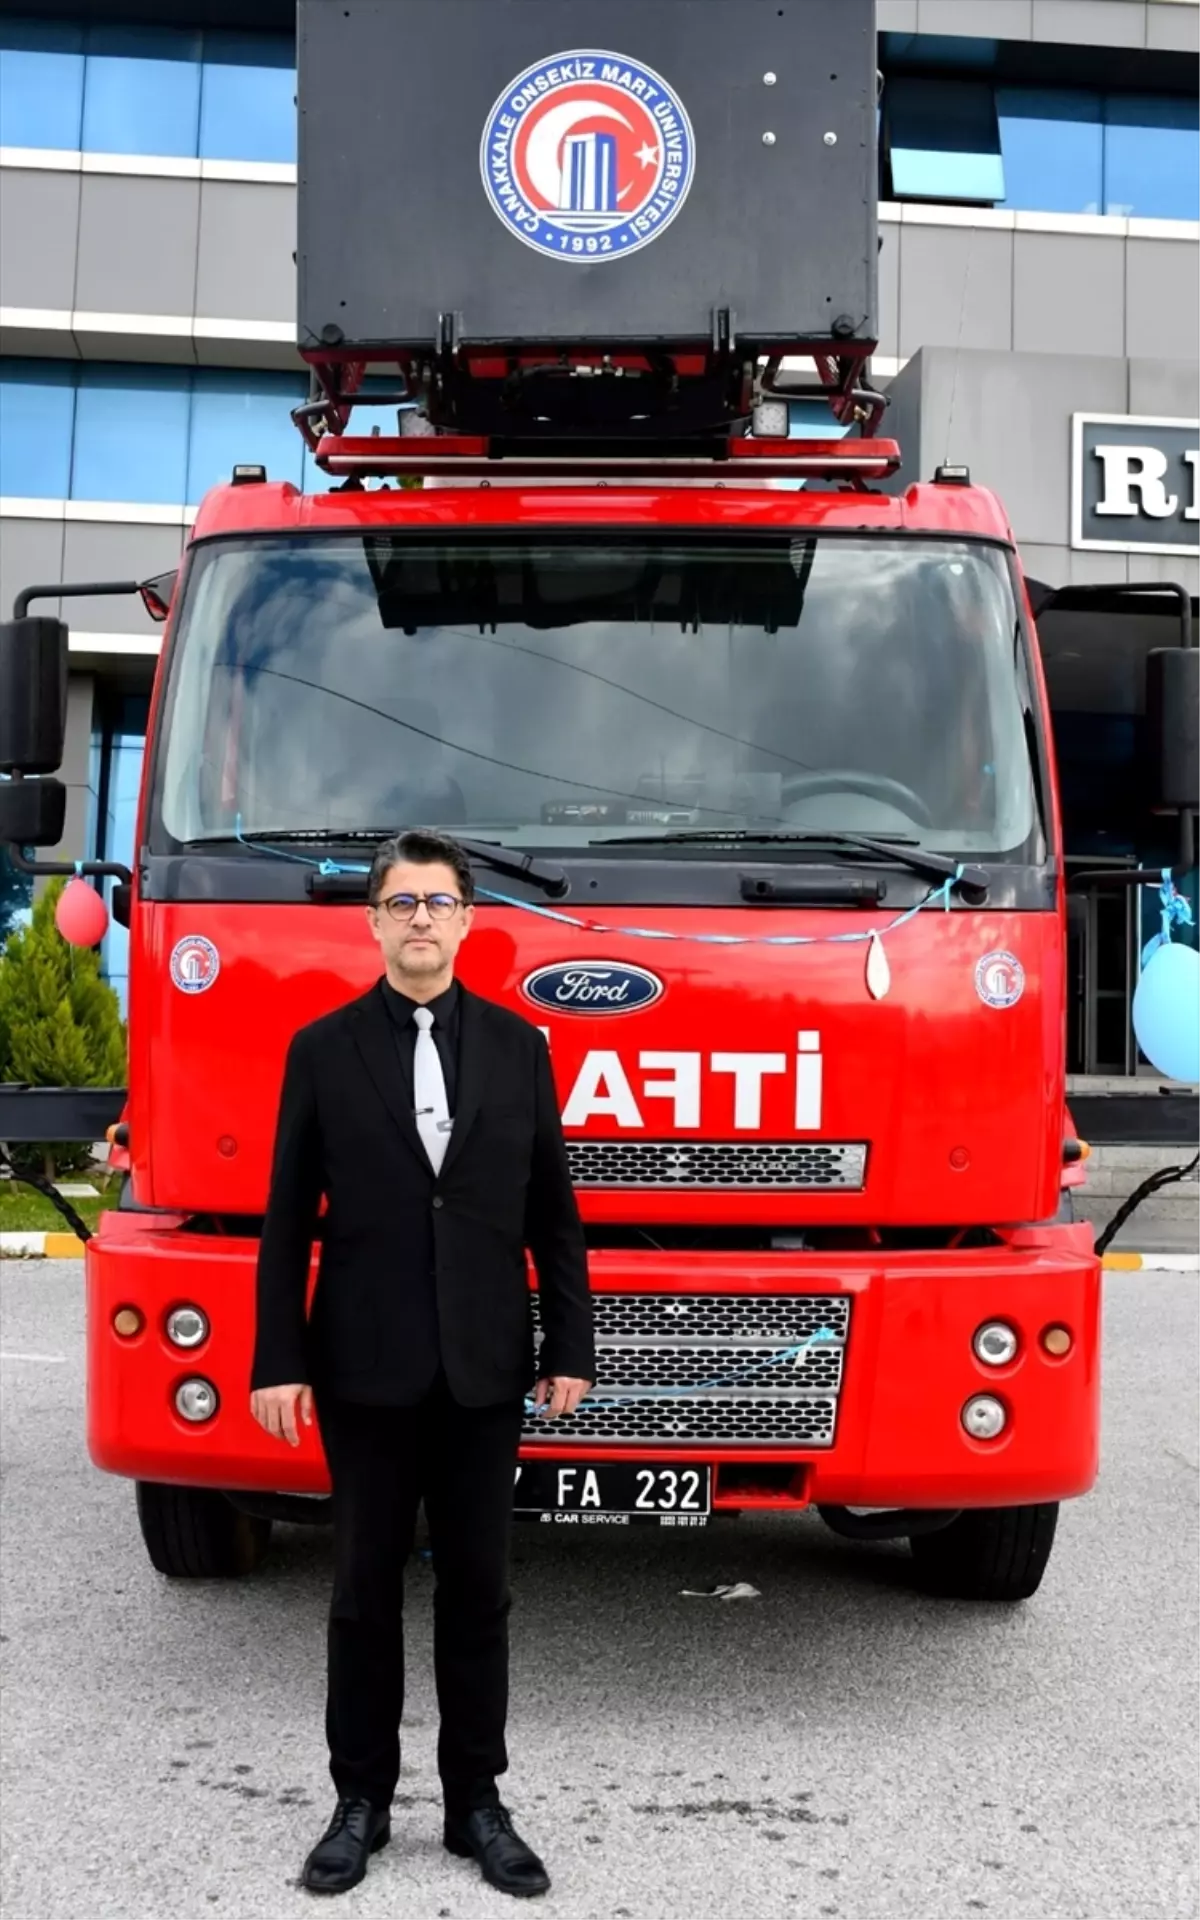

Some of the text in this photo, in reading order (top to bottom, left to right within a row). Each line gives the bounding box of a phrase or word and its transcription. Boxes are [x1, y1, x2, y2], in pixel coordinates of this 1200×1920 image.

[491, 59, 685, 239] ÇANAKKALE ONSEKİZ MART ÜNİVERSİTESİ
[559, 235, 613, 252] 1992
[555, 970, 630, 1001] Ford
[557, 1469, 602, 1508] FA
[635, 1469, 700, 1509] 232
[554, 1513, 579, 1524] CAR
[581, 1514, 630, 1525] SERVICE
